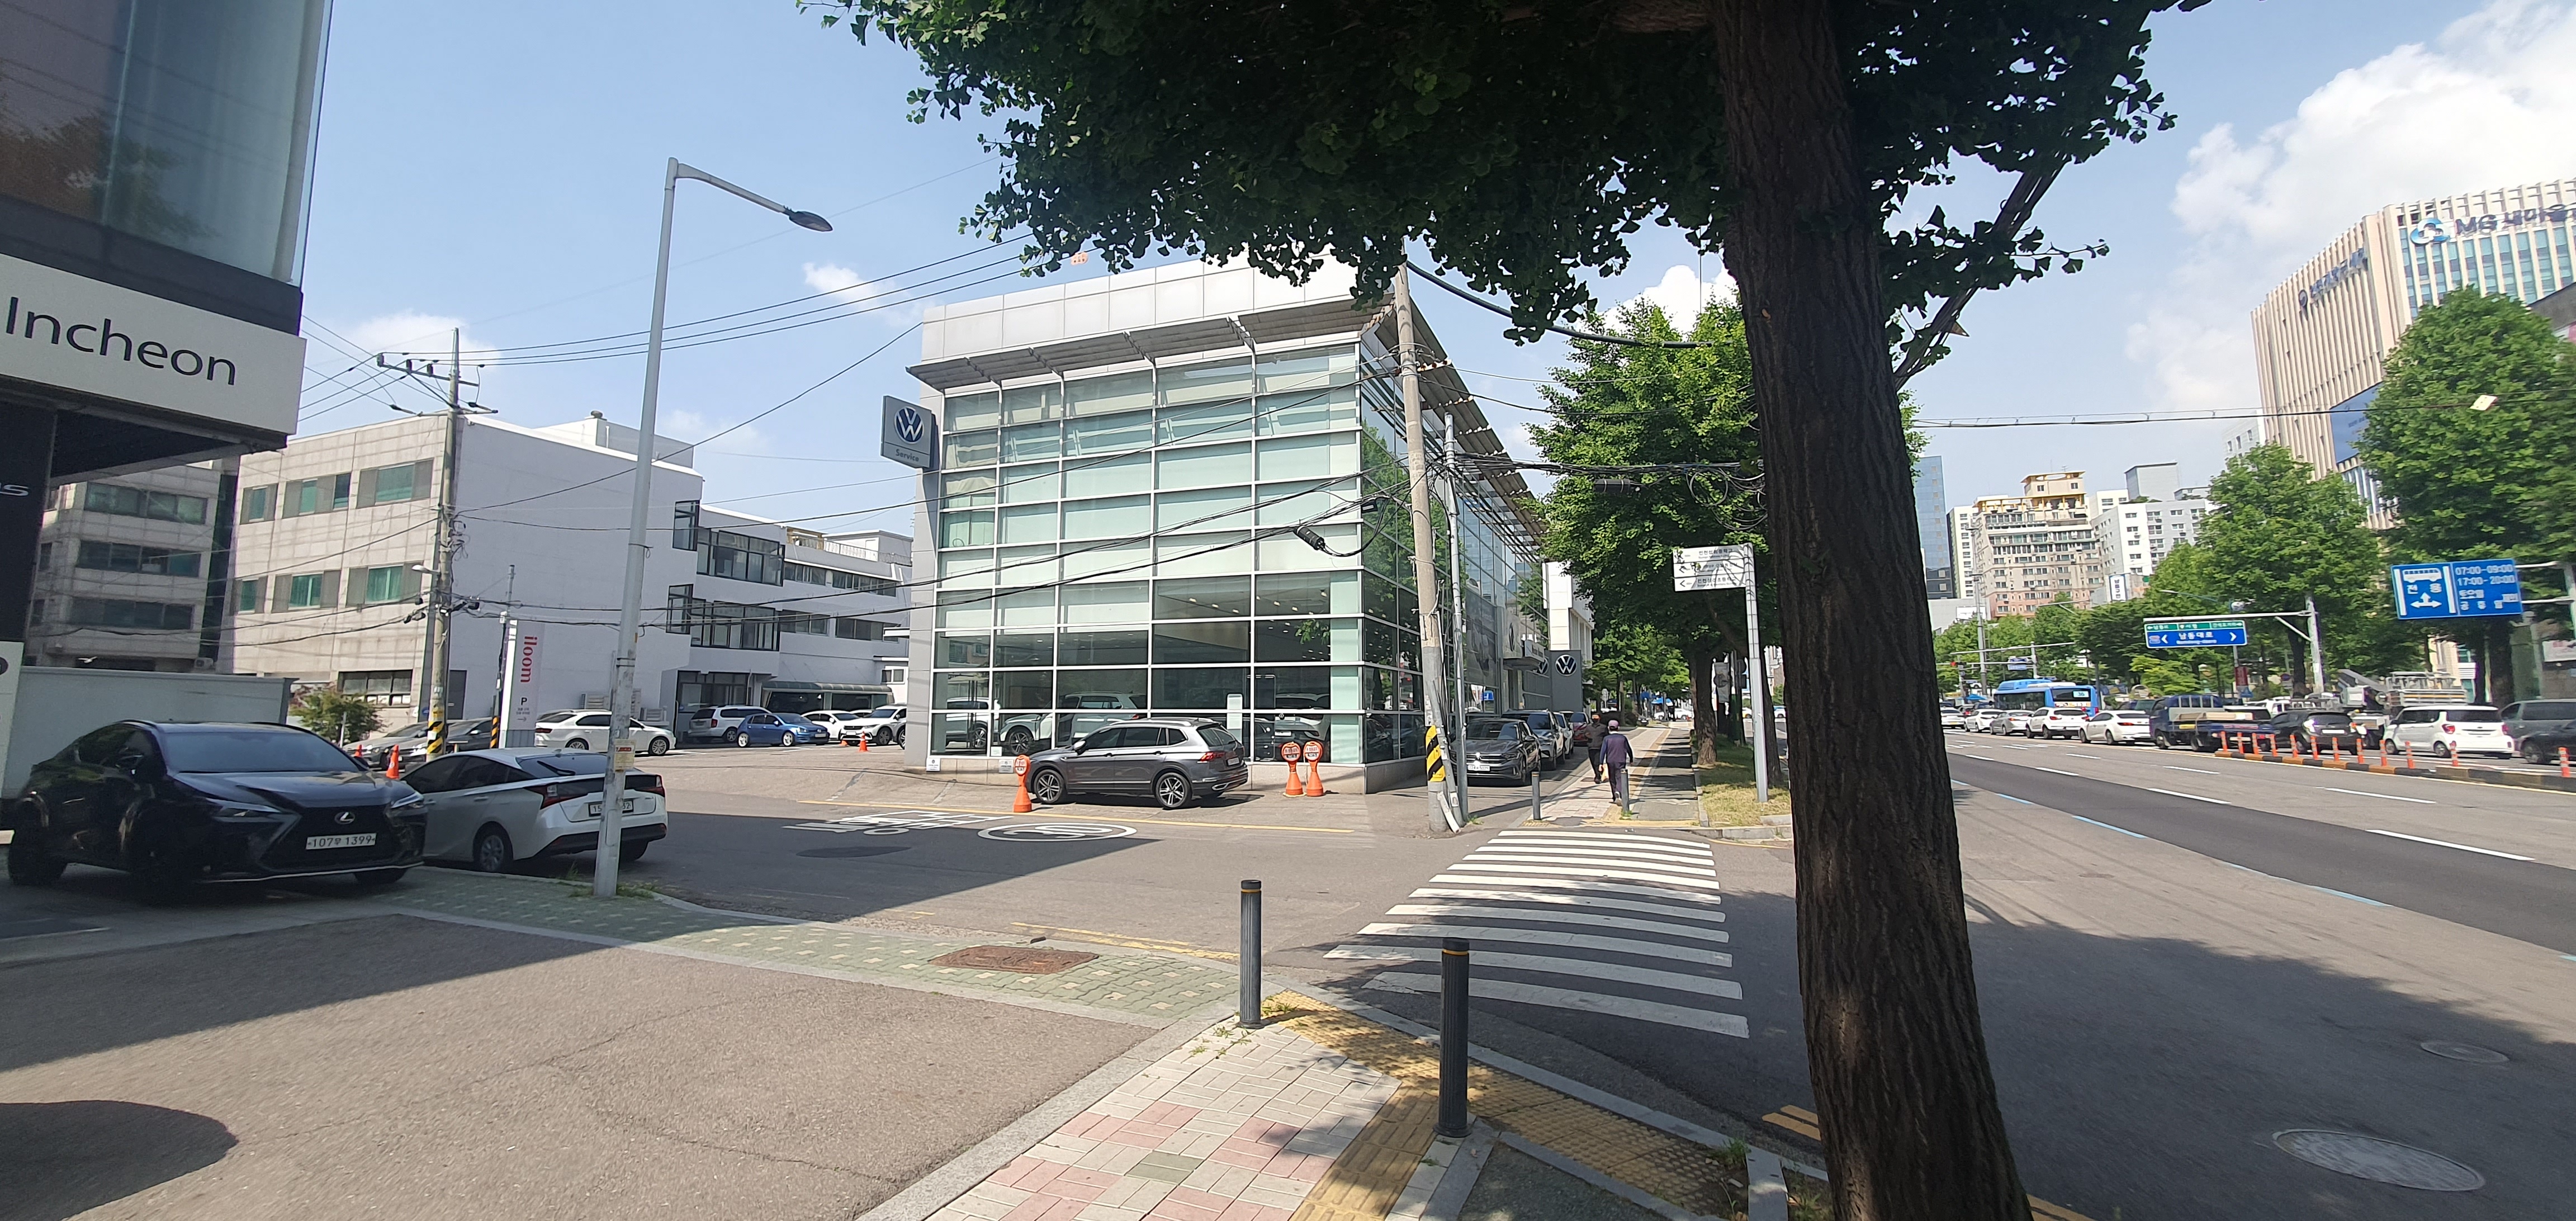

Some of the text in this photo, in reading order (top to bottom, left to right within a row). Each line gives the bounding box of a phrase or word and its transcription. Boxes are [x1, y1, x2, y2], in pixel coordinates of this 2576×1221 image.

[2455, 214, 2498, 234] MG
[6, 296, 236, 386] Incheon
[896, 449, 919, 462] Service
[2178, 631, 2214, 640] 남동대로
[520, 636, 538, 683] iloom
[520, 697, 528, 706] P
[1003, 825, 1114, 839] 30
[346, 835, 372, 845] 1399
